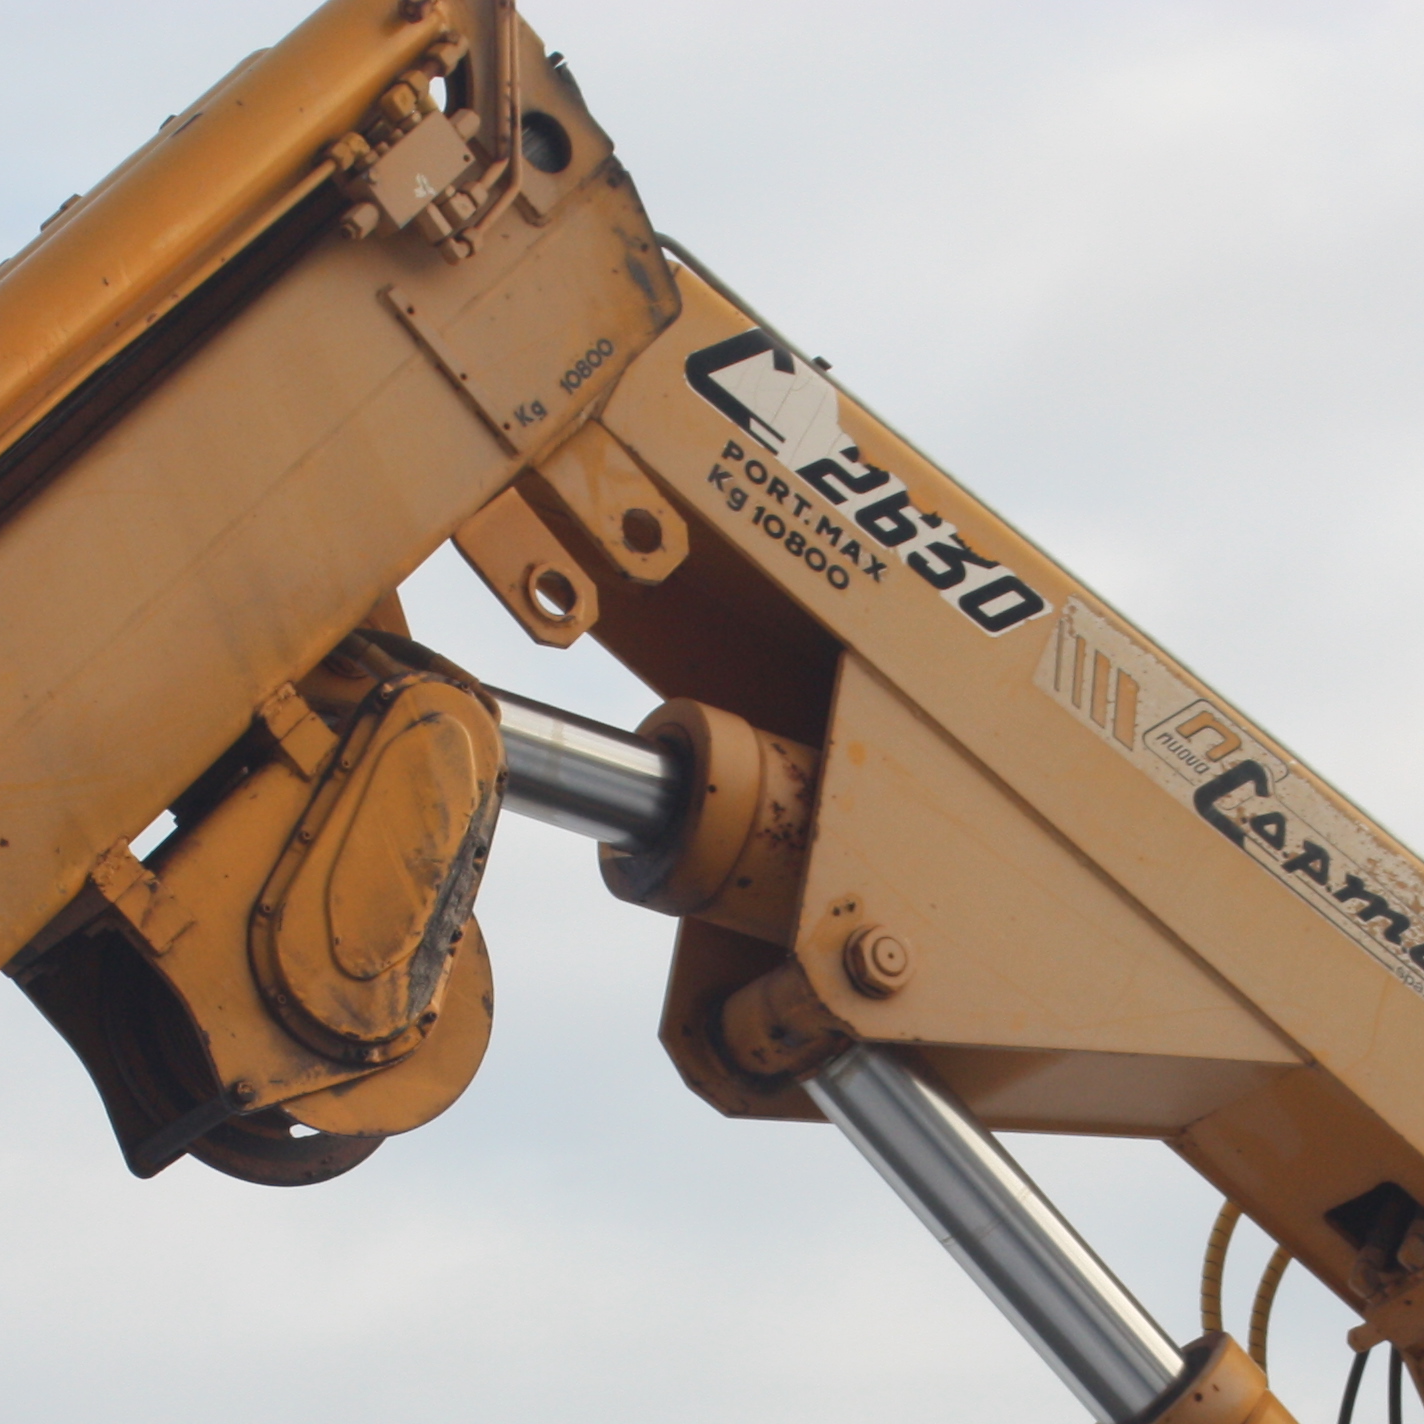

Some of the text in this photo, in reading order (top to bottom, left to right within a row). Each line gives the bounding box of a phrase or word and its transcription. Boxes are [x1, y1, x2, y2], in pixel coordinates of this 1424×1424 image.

[514, 338, 614, 428] Kg 10800
[708, 464, 850, 591] Kg 10800
[795, 446, 1045, 633] 2630
[1156, 732, 1210, 775] nuova
[1397, 966, 1424, 993] spa
